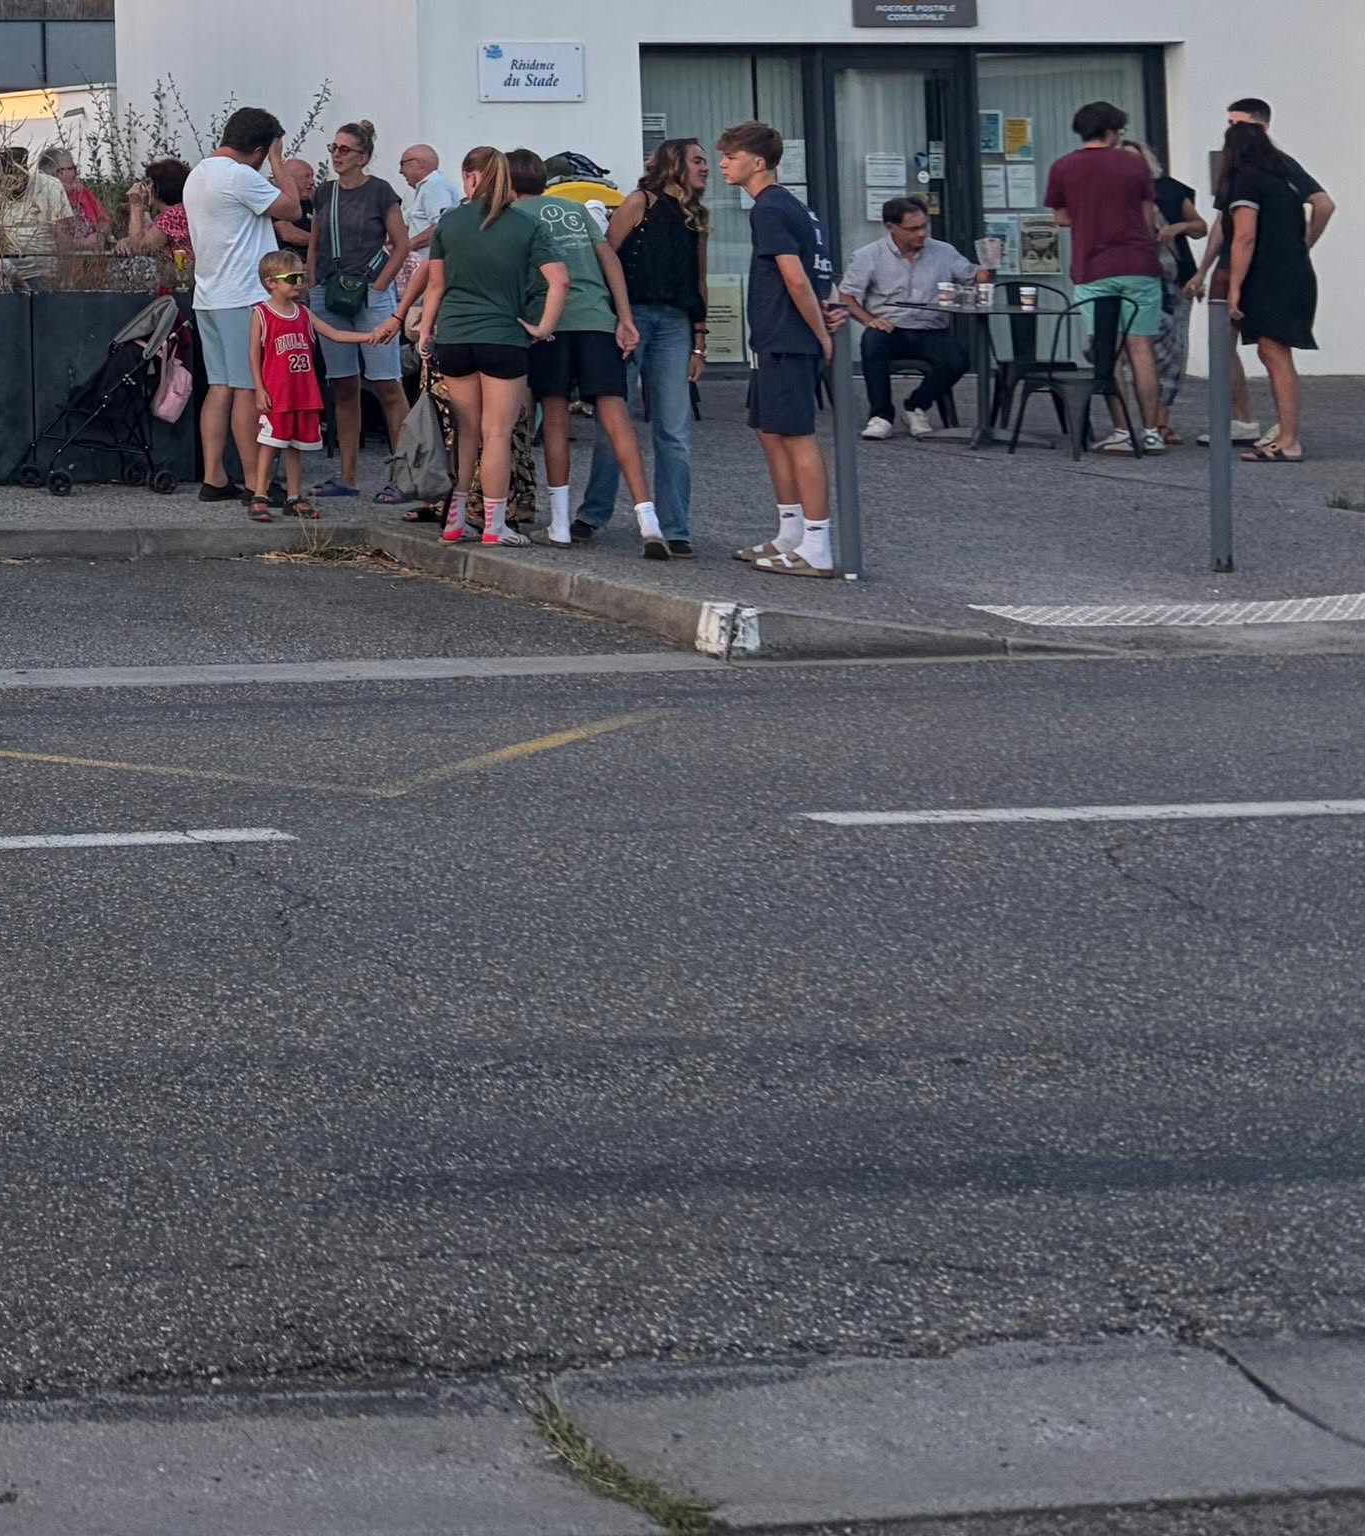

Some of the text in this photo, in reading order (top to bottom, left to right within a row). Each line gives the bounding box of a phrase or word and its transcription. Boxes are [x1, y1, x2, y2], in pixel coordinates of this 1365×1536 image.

[510, 59, 556, 70] Résidence
[503, 72, 559, 87] du Stade
[274, 333, 309, 356] BULL
[288, 353, 311, 373] 23
